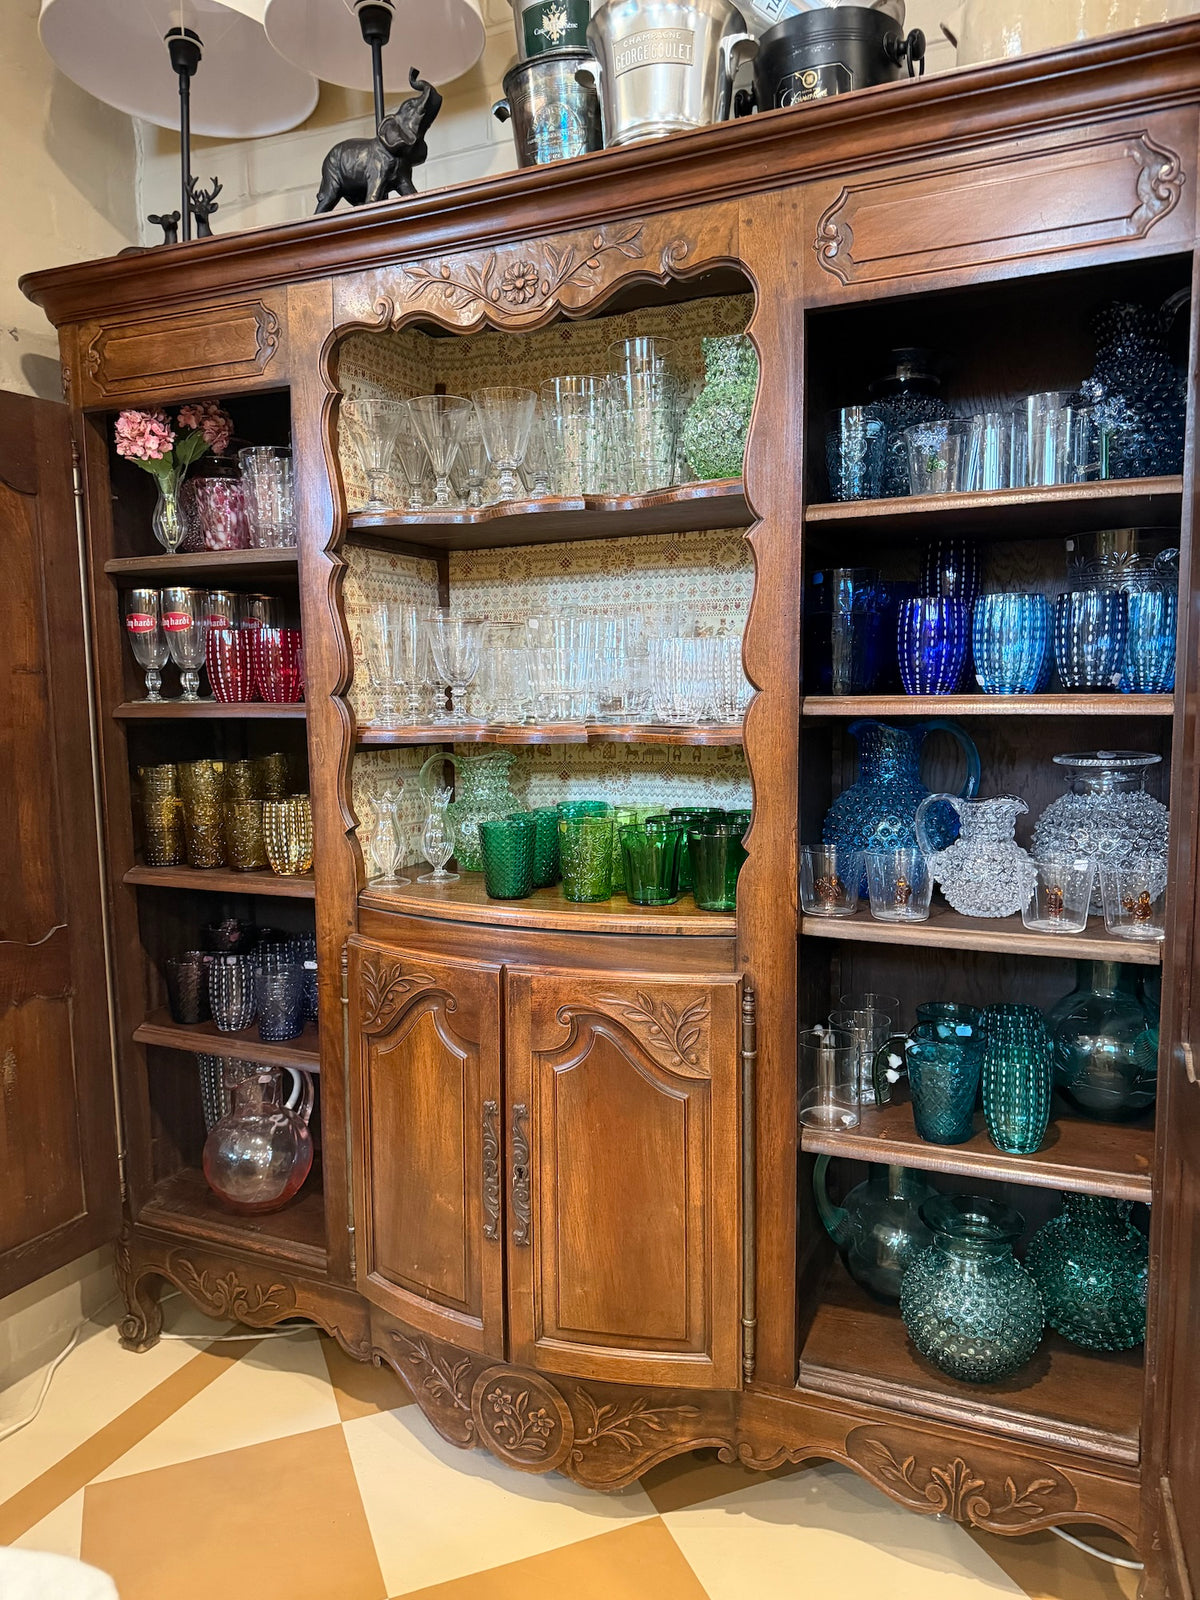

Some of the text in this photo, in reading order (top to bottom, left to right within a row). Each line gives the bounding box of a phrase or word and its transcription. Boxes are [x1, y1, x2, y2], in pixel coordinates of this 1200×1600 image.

[623, 31, 681, 48] CHAMPAGNE
[615, 42, 692, 71] GEORGE GOULET
